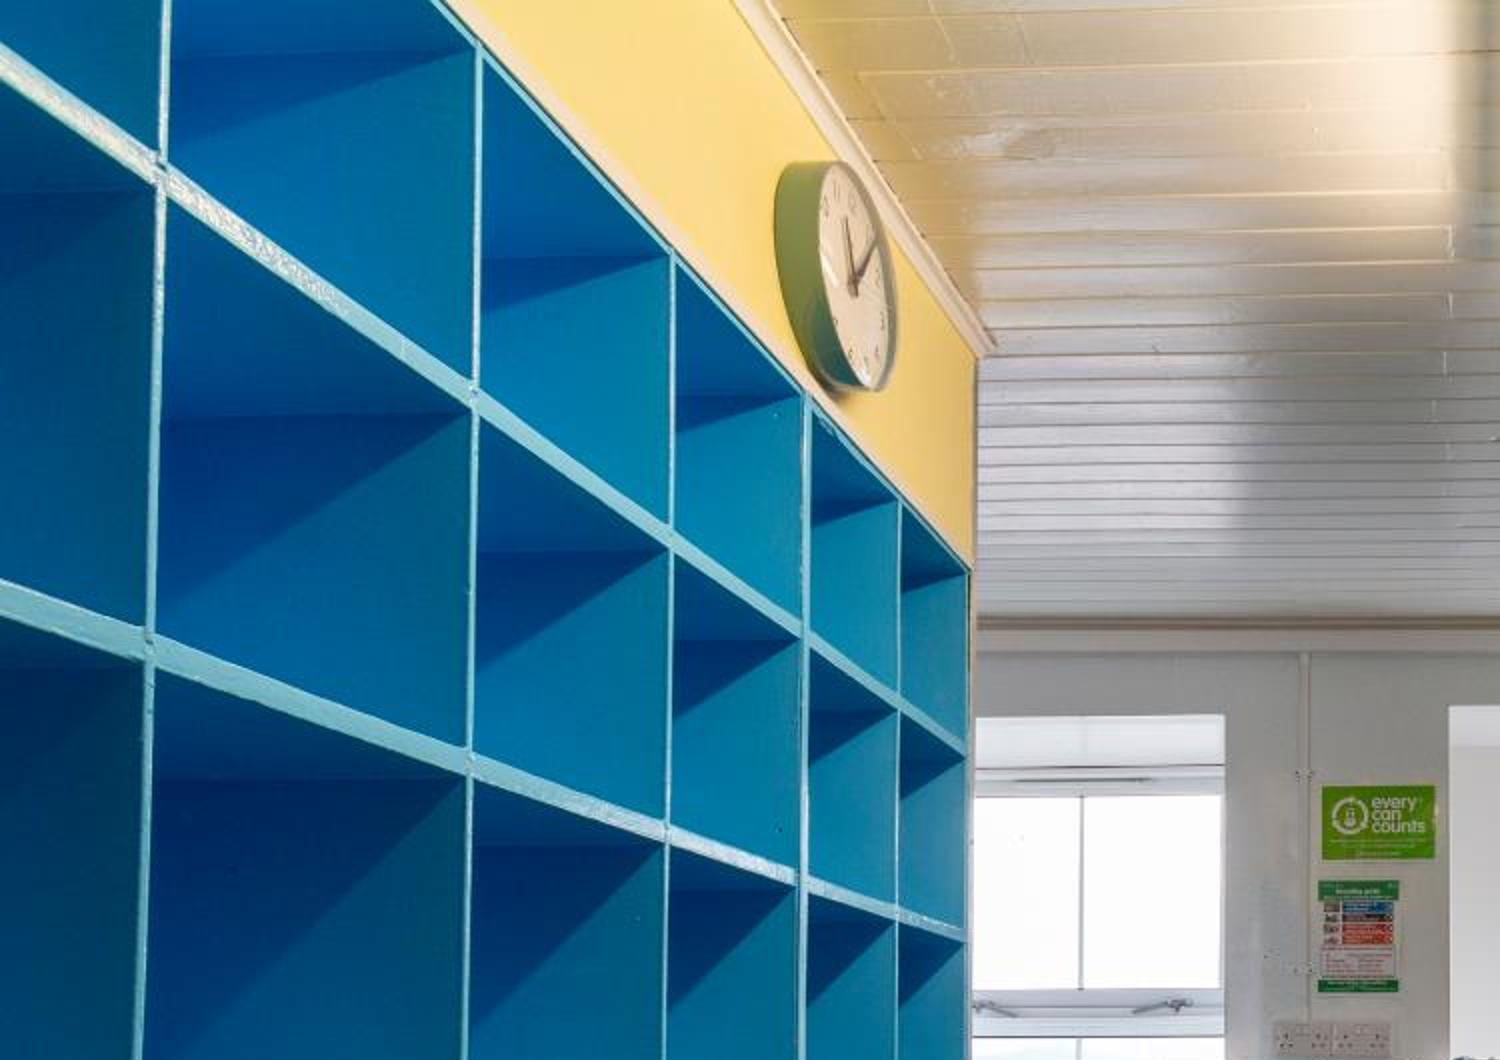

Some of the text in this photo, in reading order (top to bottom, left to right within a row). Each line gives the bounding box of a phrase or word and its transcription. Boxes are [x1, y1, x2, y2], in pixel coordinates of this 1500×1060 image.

[1371, 796, 1417, 814] every
[1371, 810, 1402, 821] can
[1371, 819, 1426, 833] counts
